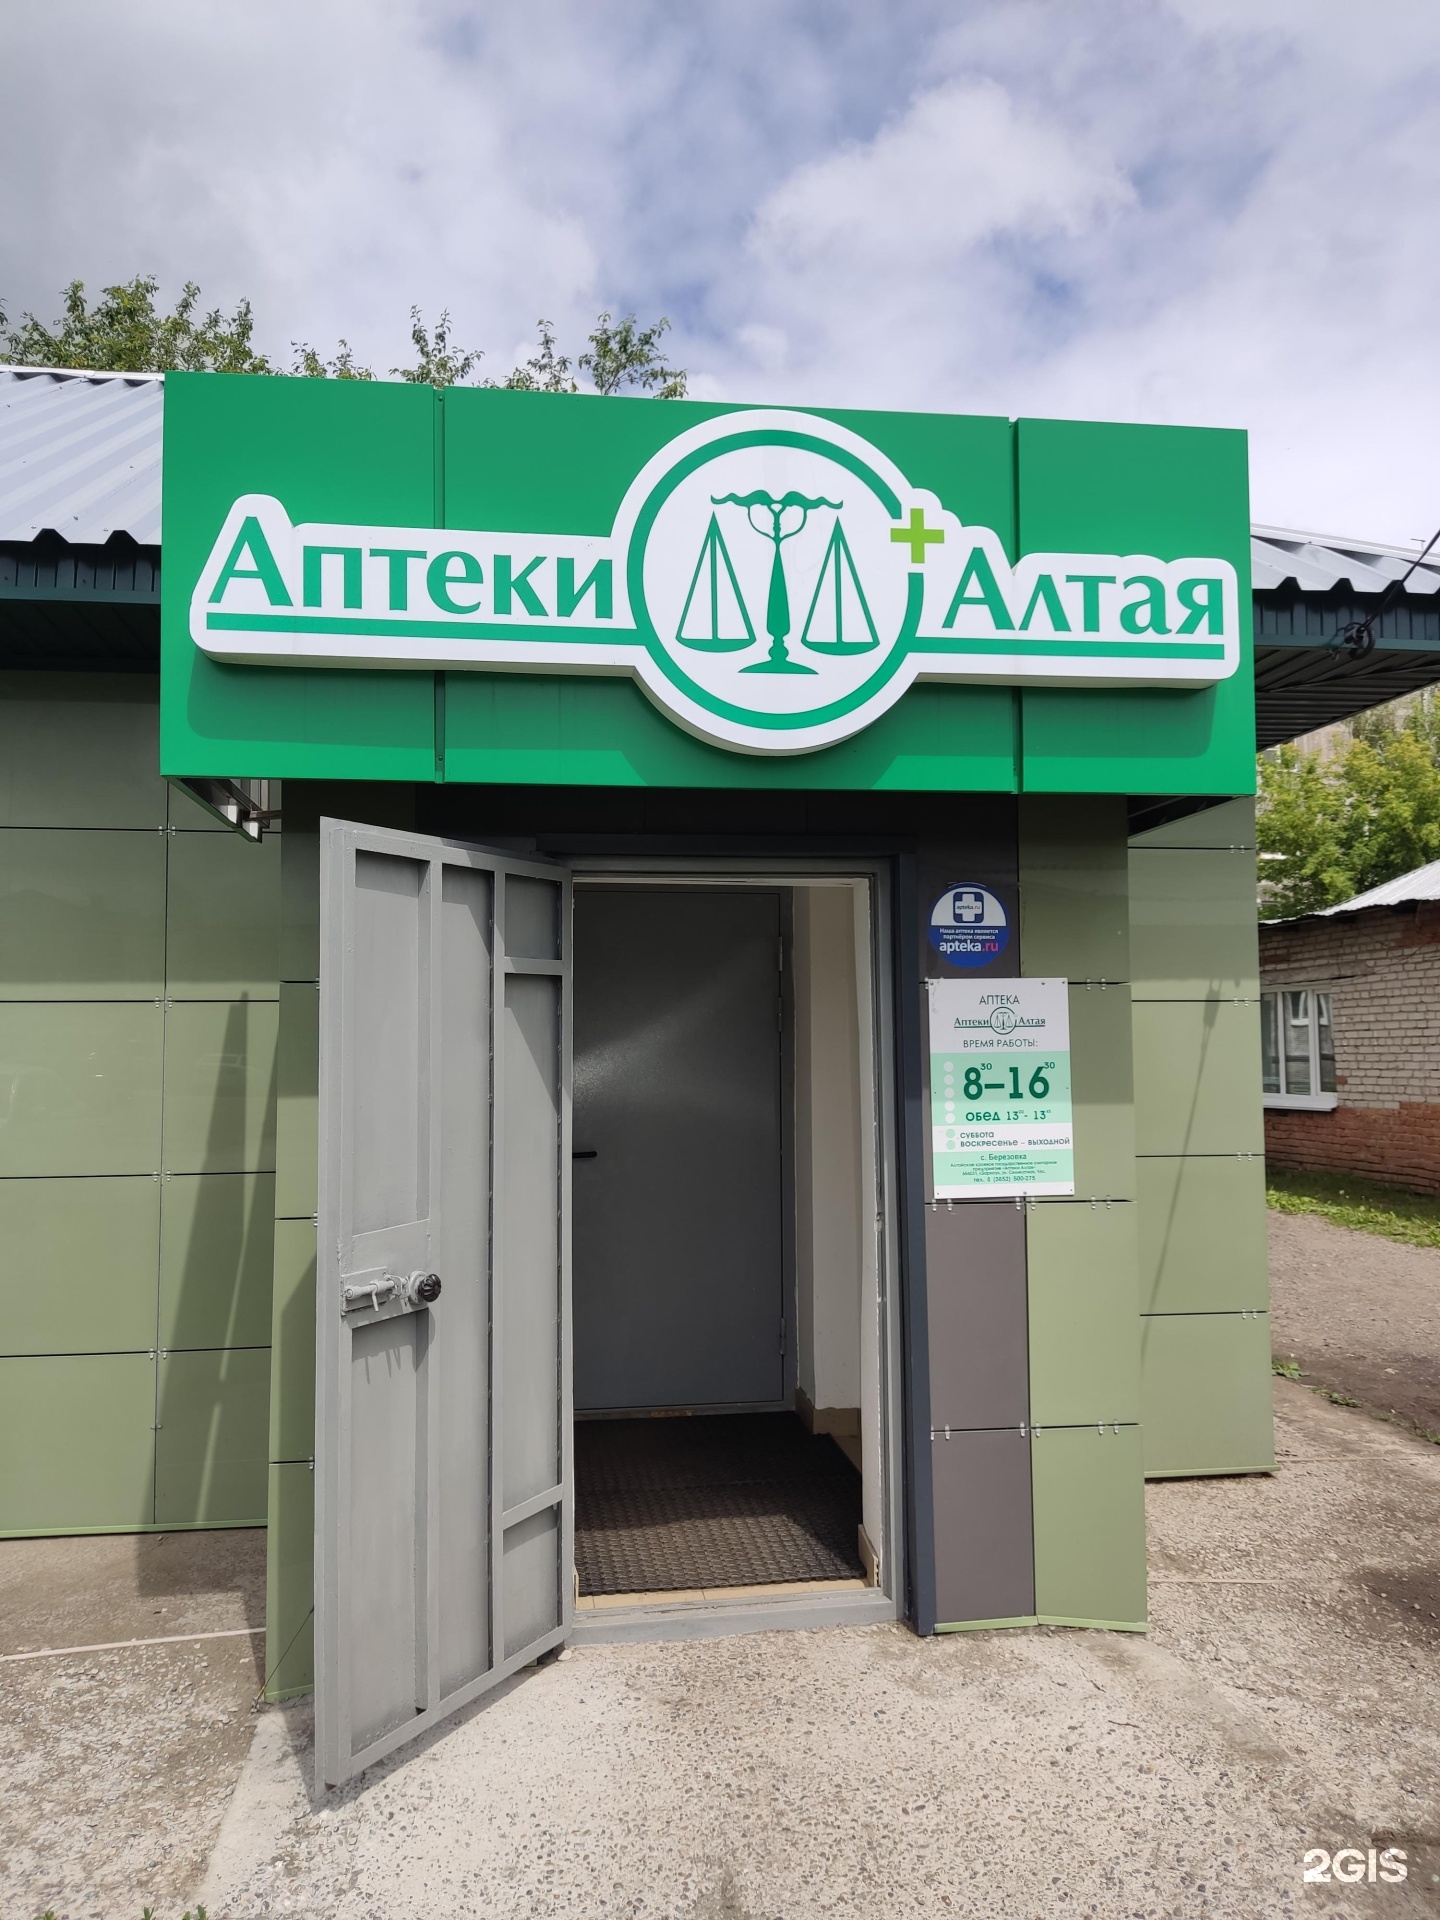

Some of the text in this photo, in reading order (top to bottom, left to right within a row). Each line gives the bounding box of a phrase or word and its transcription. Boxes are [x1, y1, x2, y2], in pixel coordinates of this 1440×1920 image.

[207, 516, 1223, 635] Аптеки Алтая
[939, 940, 999, 954] apteka.ru
[979, 995, 1020, 1005] АПТЕКА
[954, 1016, 1046, 1026] Аптеки Алтая
[963, 1039, 1038, 1048] ВРЕМЯ РАБОТЫ:
[988, 1153, 1027, 1162] Березовка
